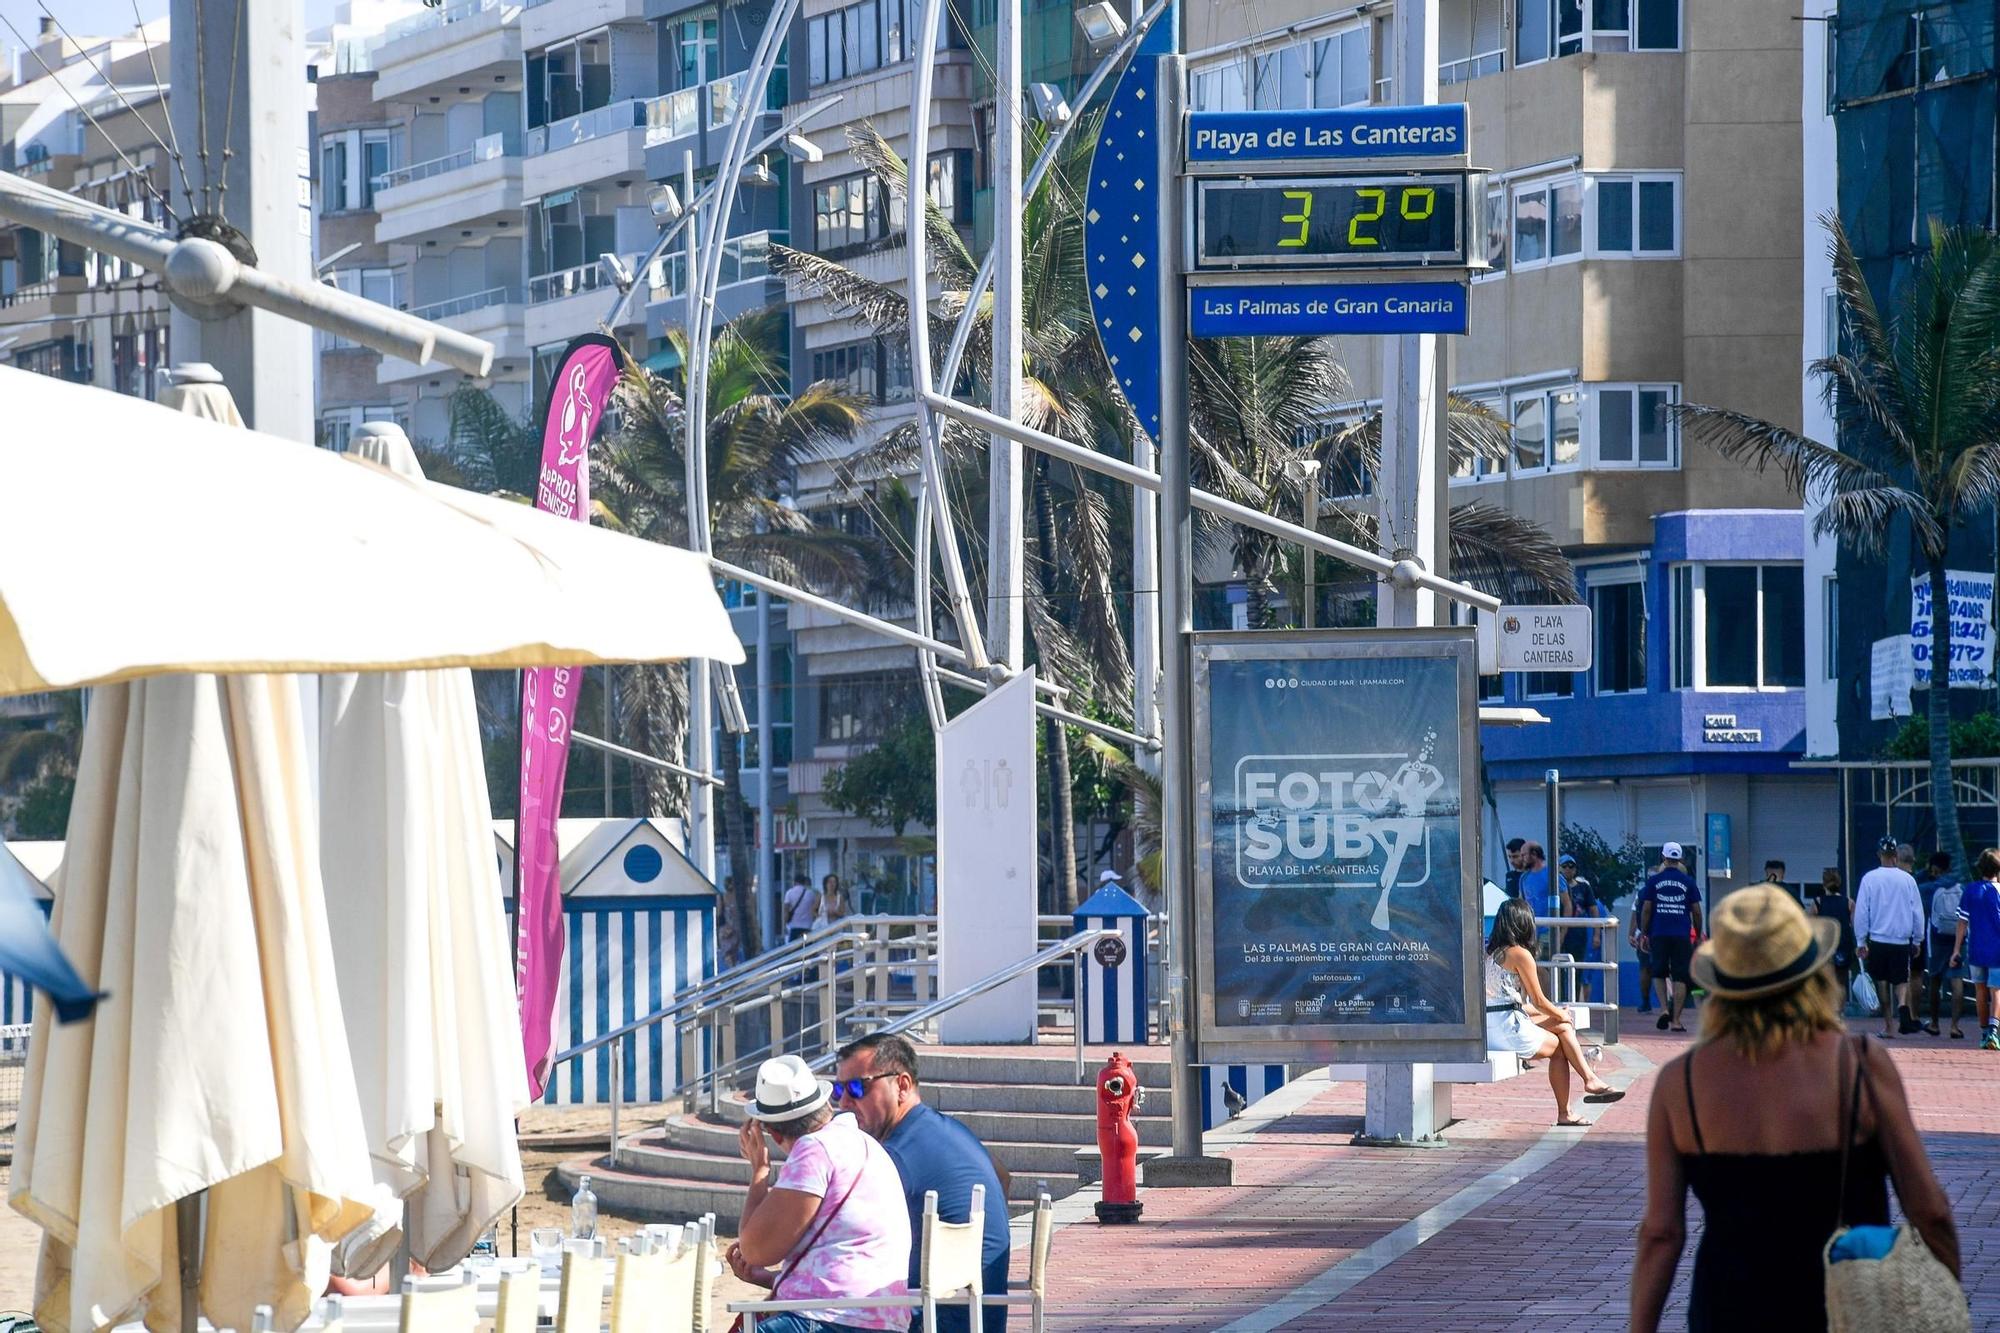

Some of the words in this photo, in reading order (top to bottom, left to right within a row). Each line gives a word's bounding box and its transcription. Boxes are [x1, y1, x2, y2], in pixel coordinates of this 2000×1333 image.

[1196, 129, 1259, 155] Playa
[1266, 127, 1297, 148] de
[1304, 126, 1343, 146] Las
[1351, 123, 1457, 145] Canteras
[1204, 300, 1233, 315] Las
[1239, 300, 1301, 315] Palmas
[1306, 299, 1327, 315] de
[1334, 298, 1379, 315] Gran
[1384, 297, 1454, 314] Canaria
[1534, 615, 1564, 629] PLAYA
[1532, 633, 1544, 646] DE
[1547, 633, 1565, 646] LAS
[1523, 650, 1574, 663] CANTERAS
[1328, 679, 1338, 687] DE
[1339, 679, 1354, 687] MAR
[1245, 771, 1393, 812] FOTO
[1244, 814, 1374, 860] SUB
[1248, 865, 1283, 876] PLAYA
[1285, 865, 1299, 875] DE
[1301, 865, 1321, 875] LAS
[1323, 864, 1380, 875] CANTERAS
[1243, 943, 1266, 953] LAS
[1269, 943, 1317, 953] PALMAS
[1320, 943, 1336, 952] DE
[1339, 942, 1373, 952] GRAN
[1376, 941, 1430, 952] CANARIA
[1245, 955, 1259, 963] Del
[1260, 955, 1271, 963] 28
[1285, 954, 1332, 964] septiembre
[1333, 954, 1341, 962] al
[1349, 954, 1360, 962] de
[1395, 953, 1406, 961] de
[1408, 953, 1429, 961] 2023
